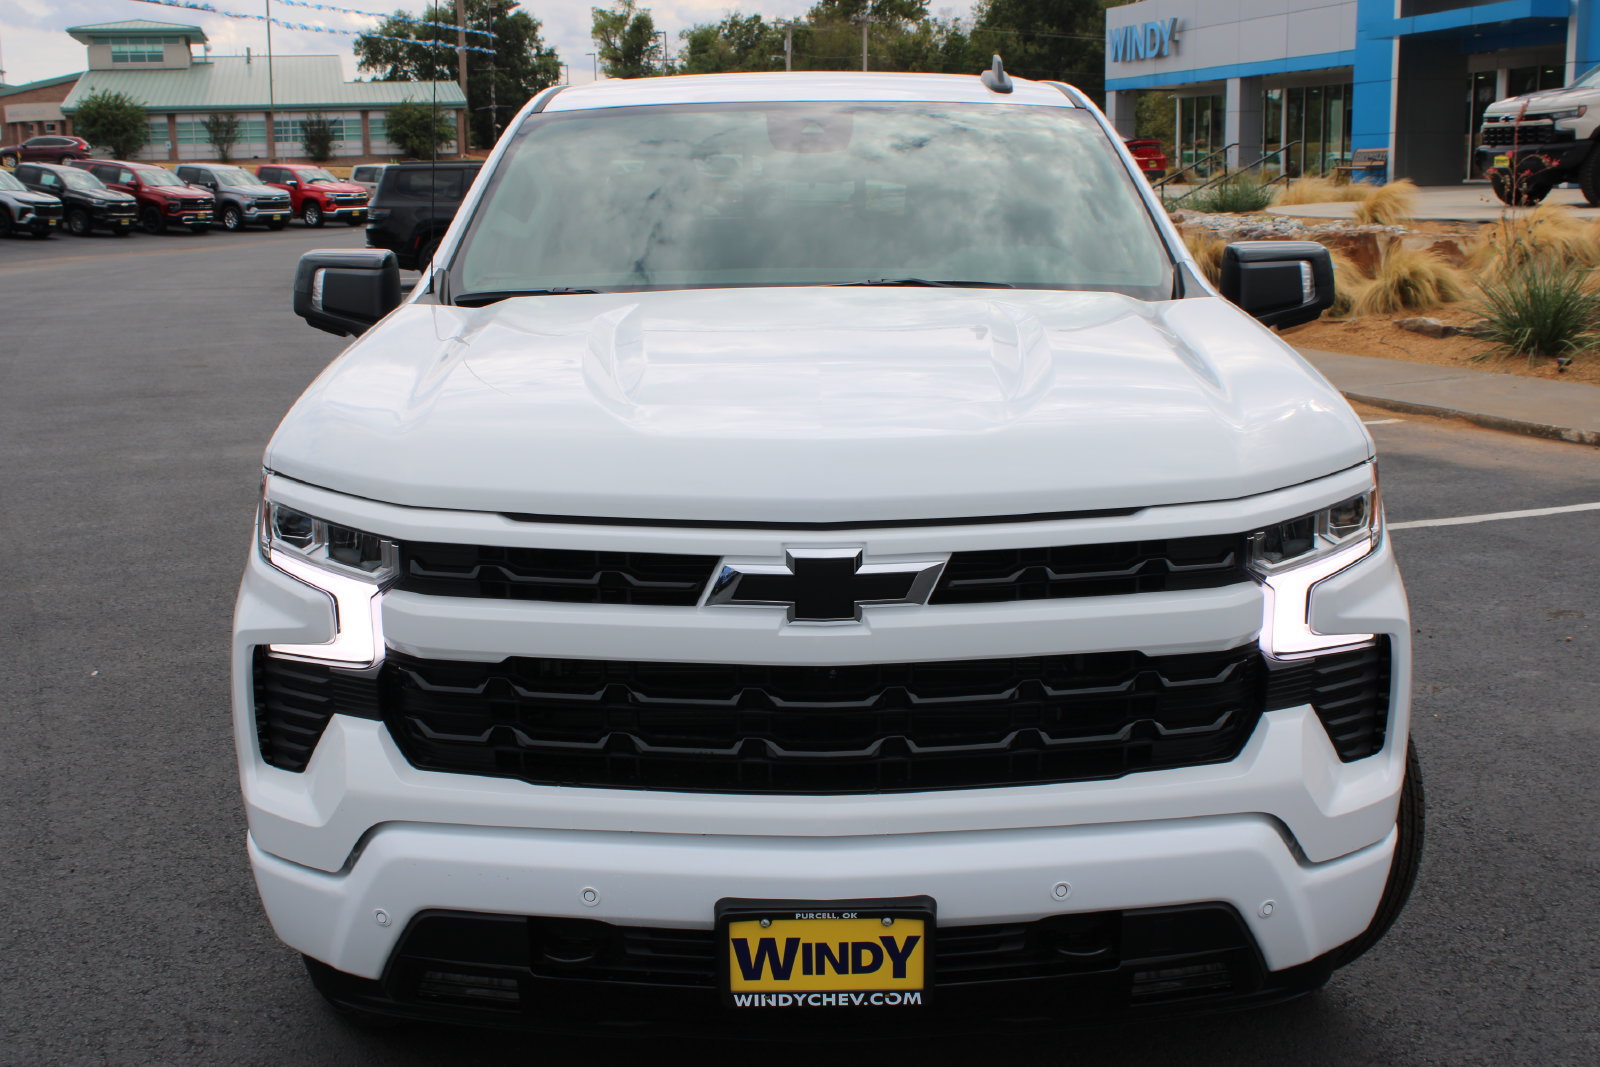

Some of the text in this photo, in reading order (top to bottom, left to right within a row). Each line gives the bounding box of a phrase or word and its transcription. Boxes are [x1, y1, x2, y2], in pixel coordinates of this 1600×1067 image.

[1108, 16, 1178, 62] WINDY
[795, 912, 840, 920] PURCELL,
[731, 935, 921, 981] WINDY
[733, 992, 922, 1007] WINDYCHEV.COM
